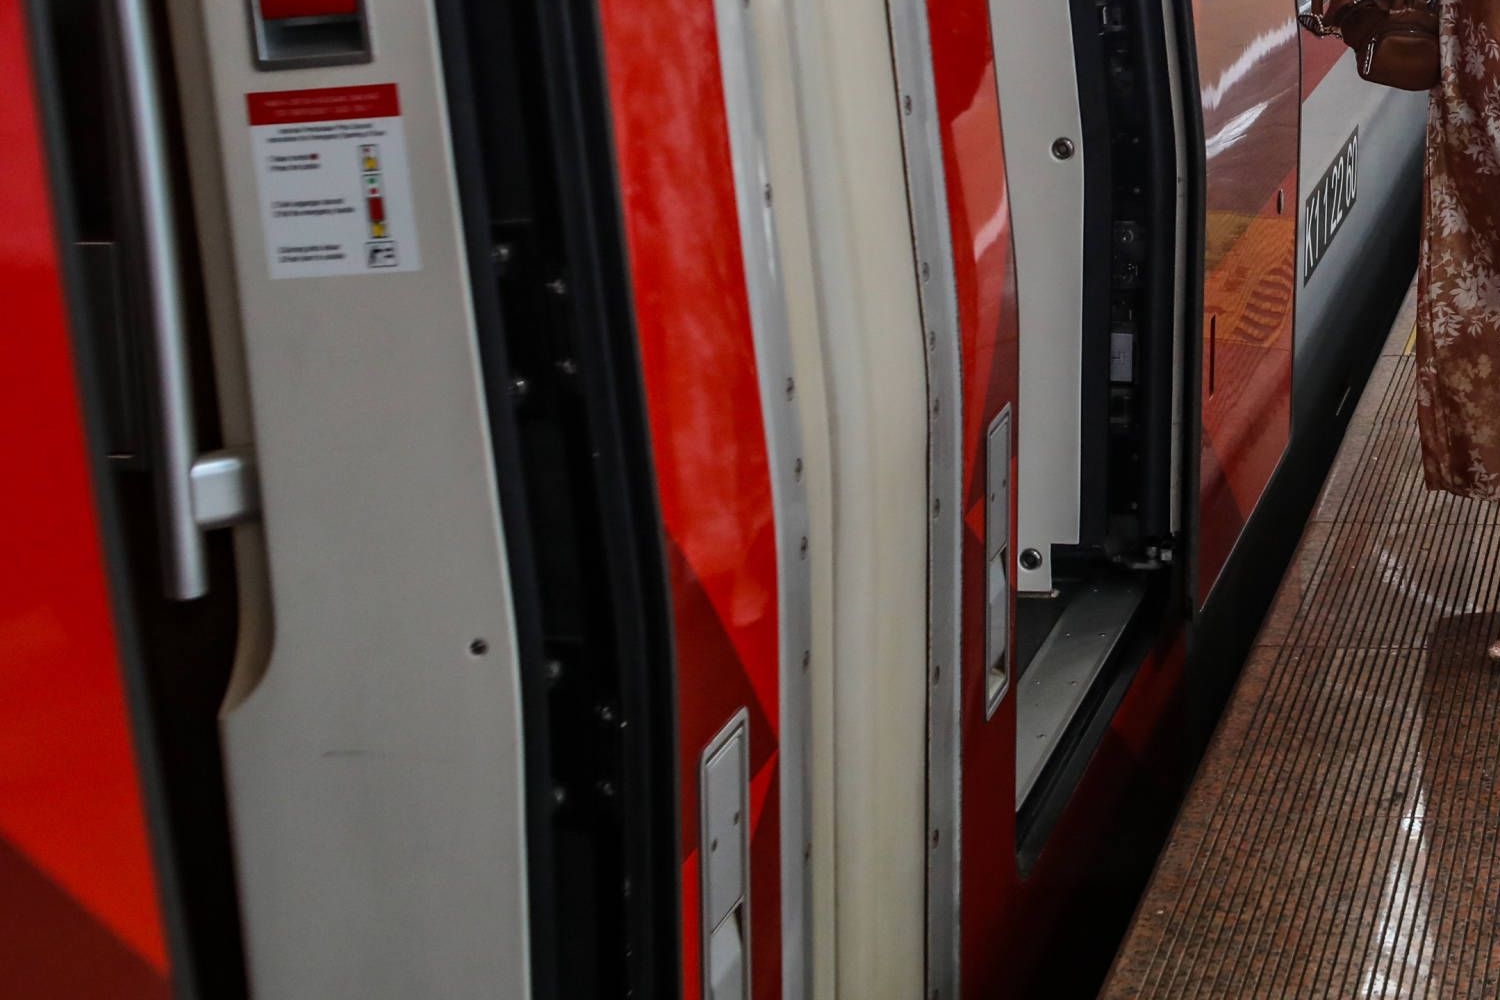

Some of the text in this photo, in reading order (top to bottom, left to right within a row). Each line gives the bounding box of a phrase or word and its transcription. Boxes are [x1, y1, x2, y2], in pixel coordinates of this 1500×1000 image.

[1305, 135, 1358, 277] K1 1 22 60
